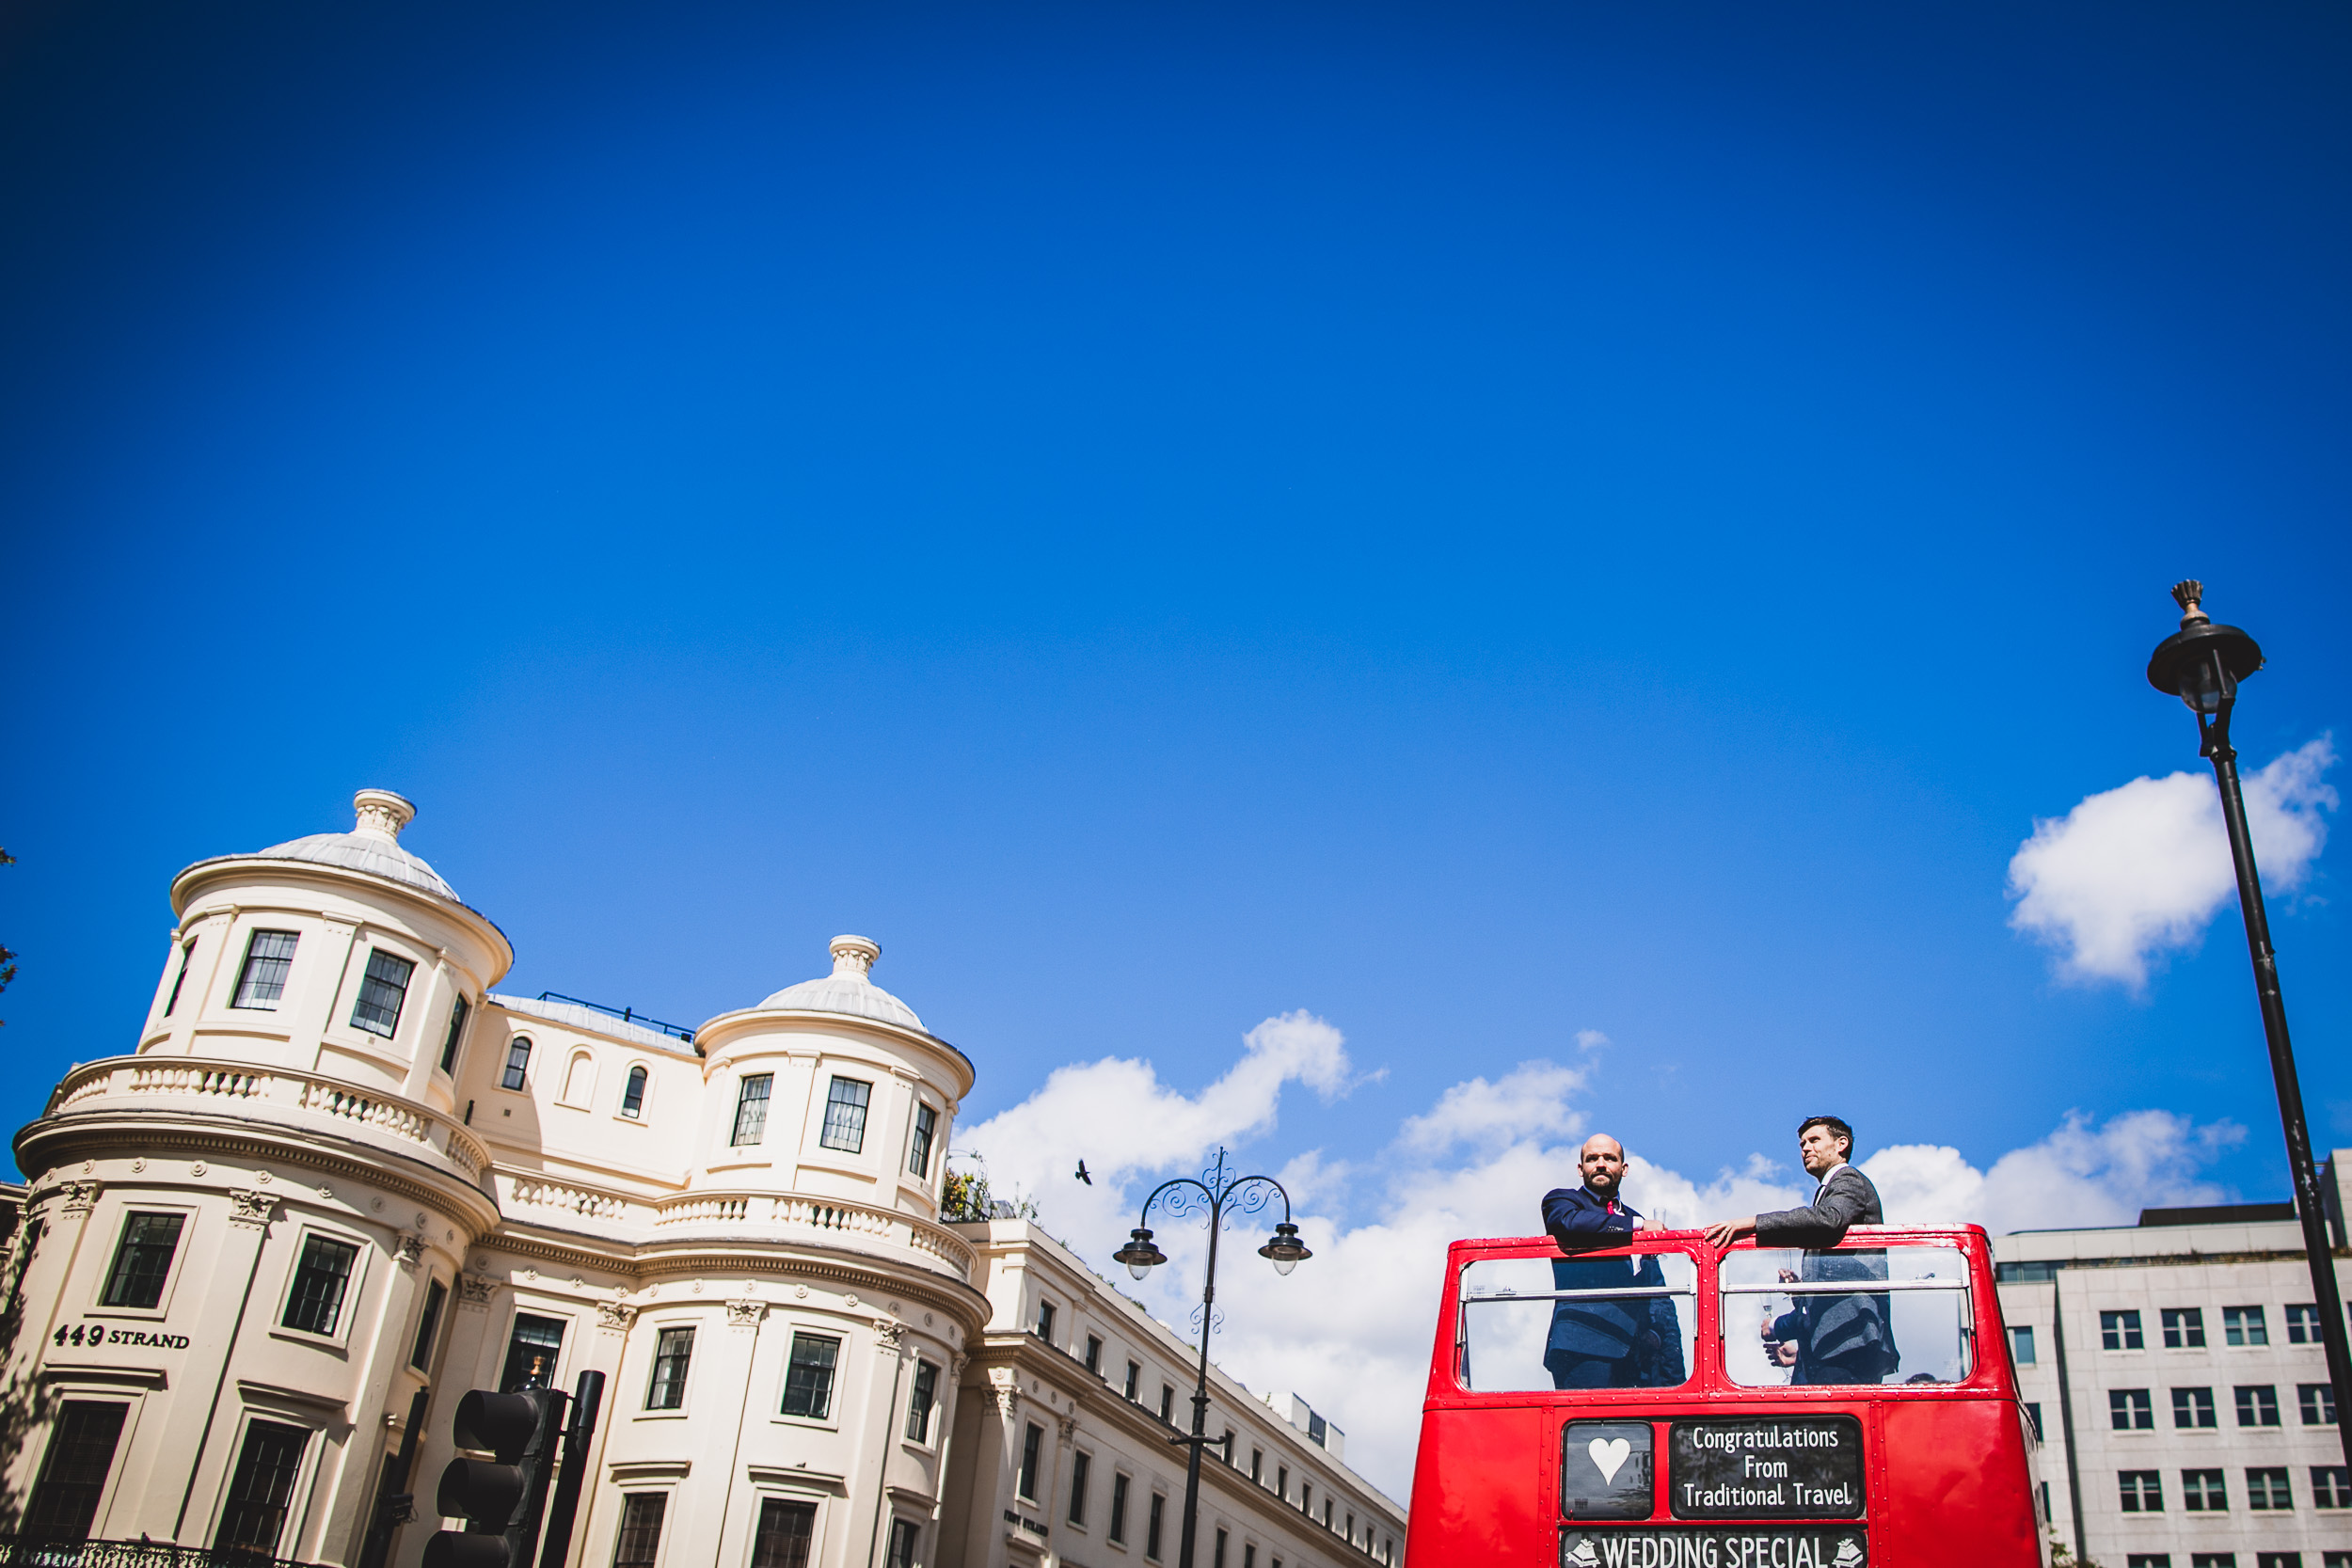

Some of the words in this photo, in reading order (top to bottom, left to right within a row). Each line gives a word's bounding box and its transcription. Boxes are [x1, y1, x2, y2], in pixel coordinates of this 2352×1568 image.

[54, 1324, 104, 1347] 449
[108, 1330, 190, 1349] STRAND
[1693, 1425, 1839, 1454] Congratulations
[1744, 1455, 1788, 1478] From
[1684, 1483, 1786, 1507] Traditional
[1793, 1482, 1852, 1506] Travel
[1601, 1537, 1718, 1568] WEDDING
[1724, 1537, 1829, 1568] SPECIAL
